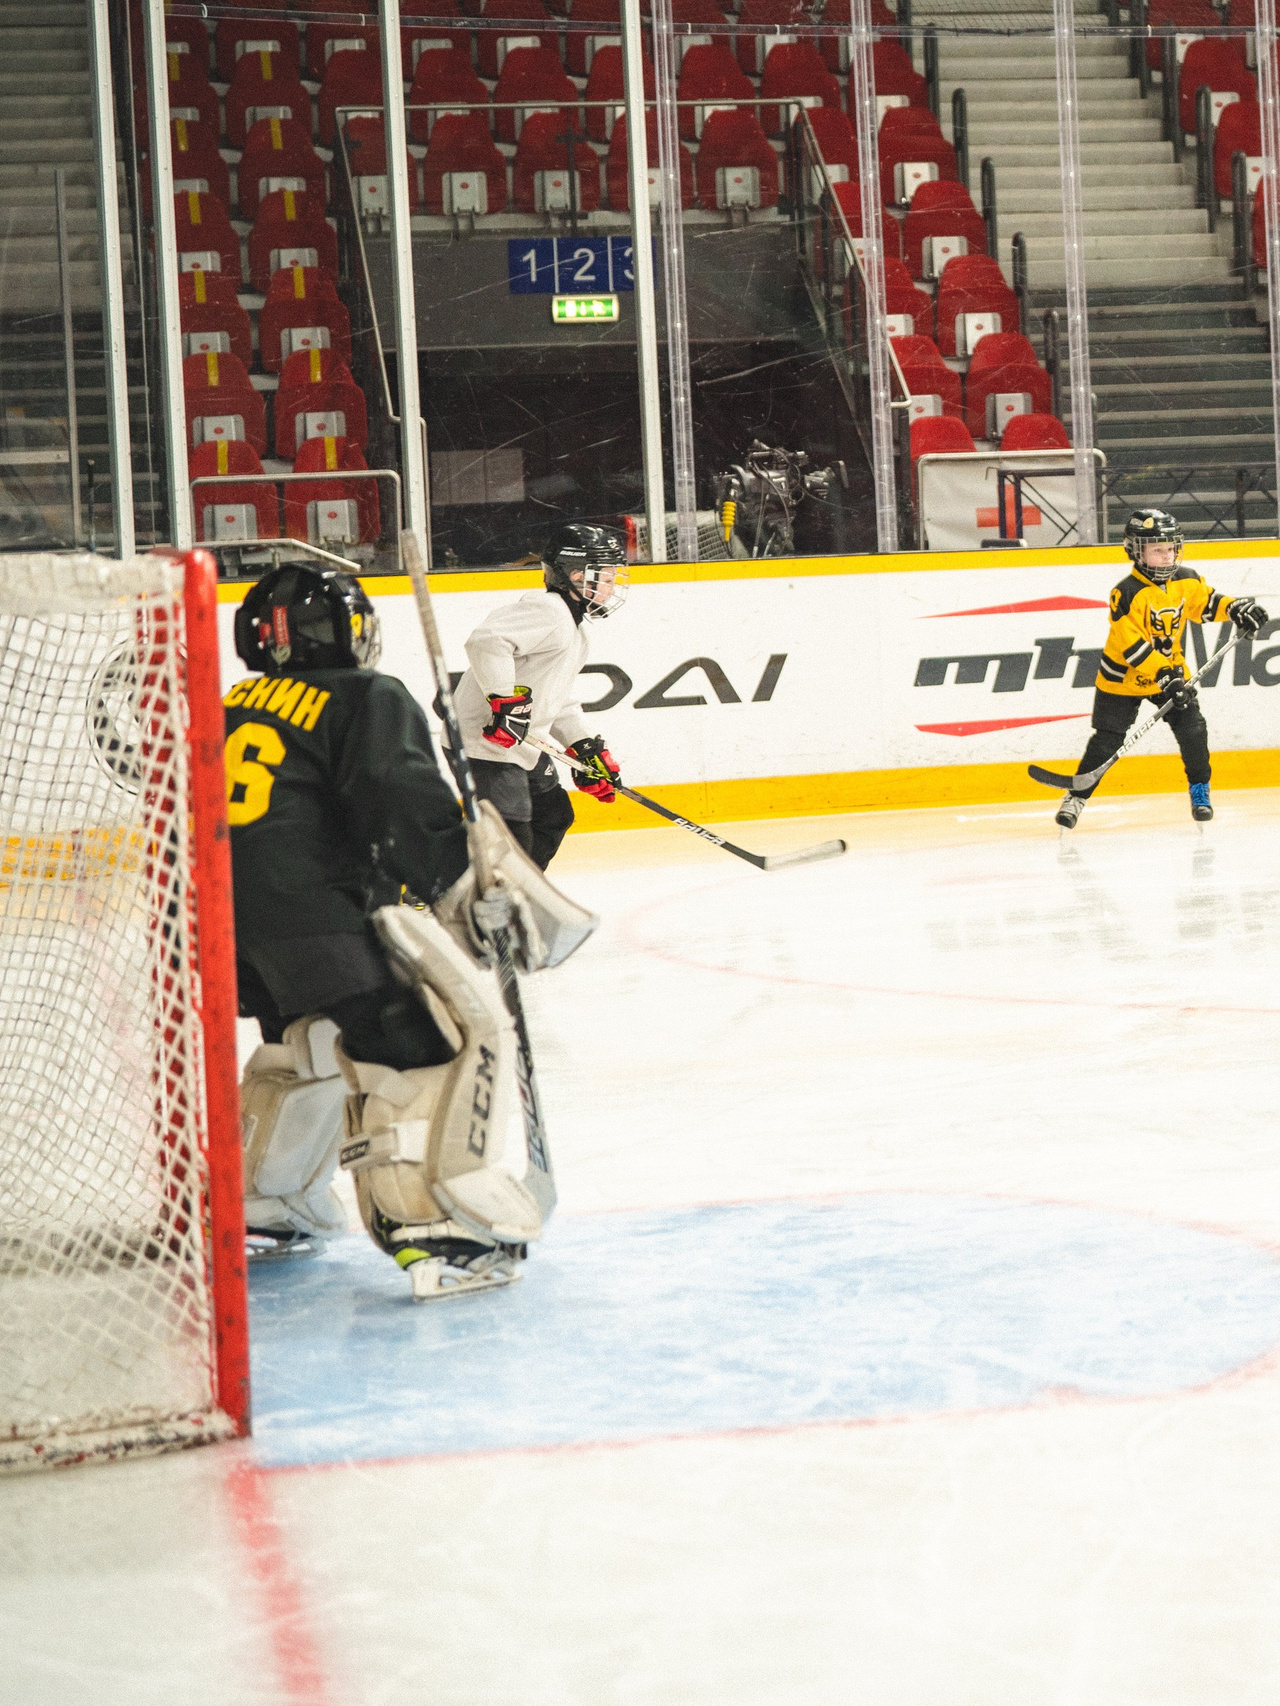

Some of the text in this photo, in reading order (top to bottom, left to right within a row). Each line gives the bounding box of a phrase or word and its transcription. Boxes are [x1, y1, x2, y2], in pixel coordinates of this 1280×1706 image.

[522, 249, 537, 282] 1
[573, 248, 596, 281] 2
[1117, 716, 1156, 758] BAUER
[674, 817, 725, 847] BAUER
[467, 1044, 496, 1158] CCM
